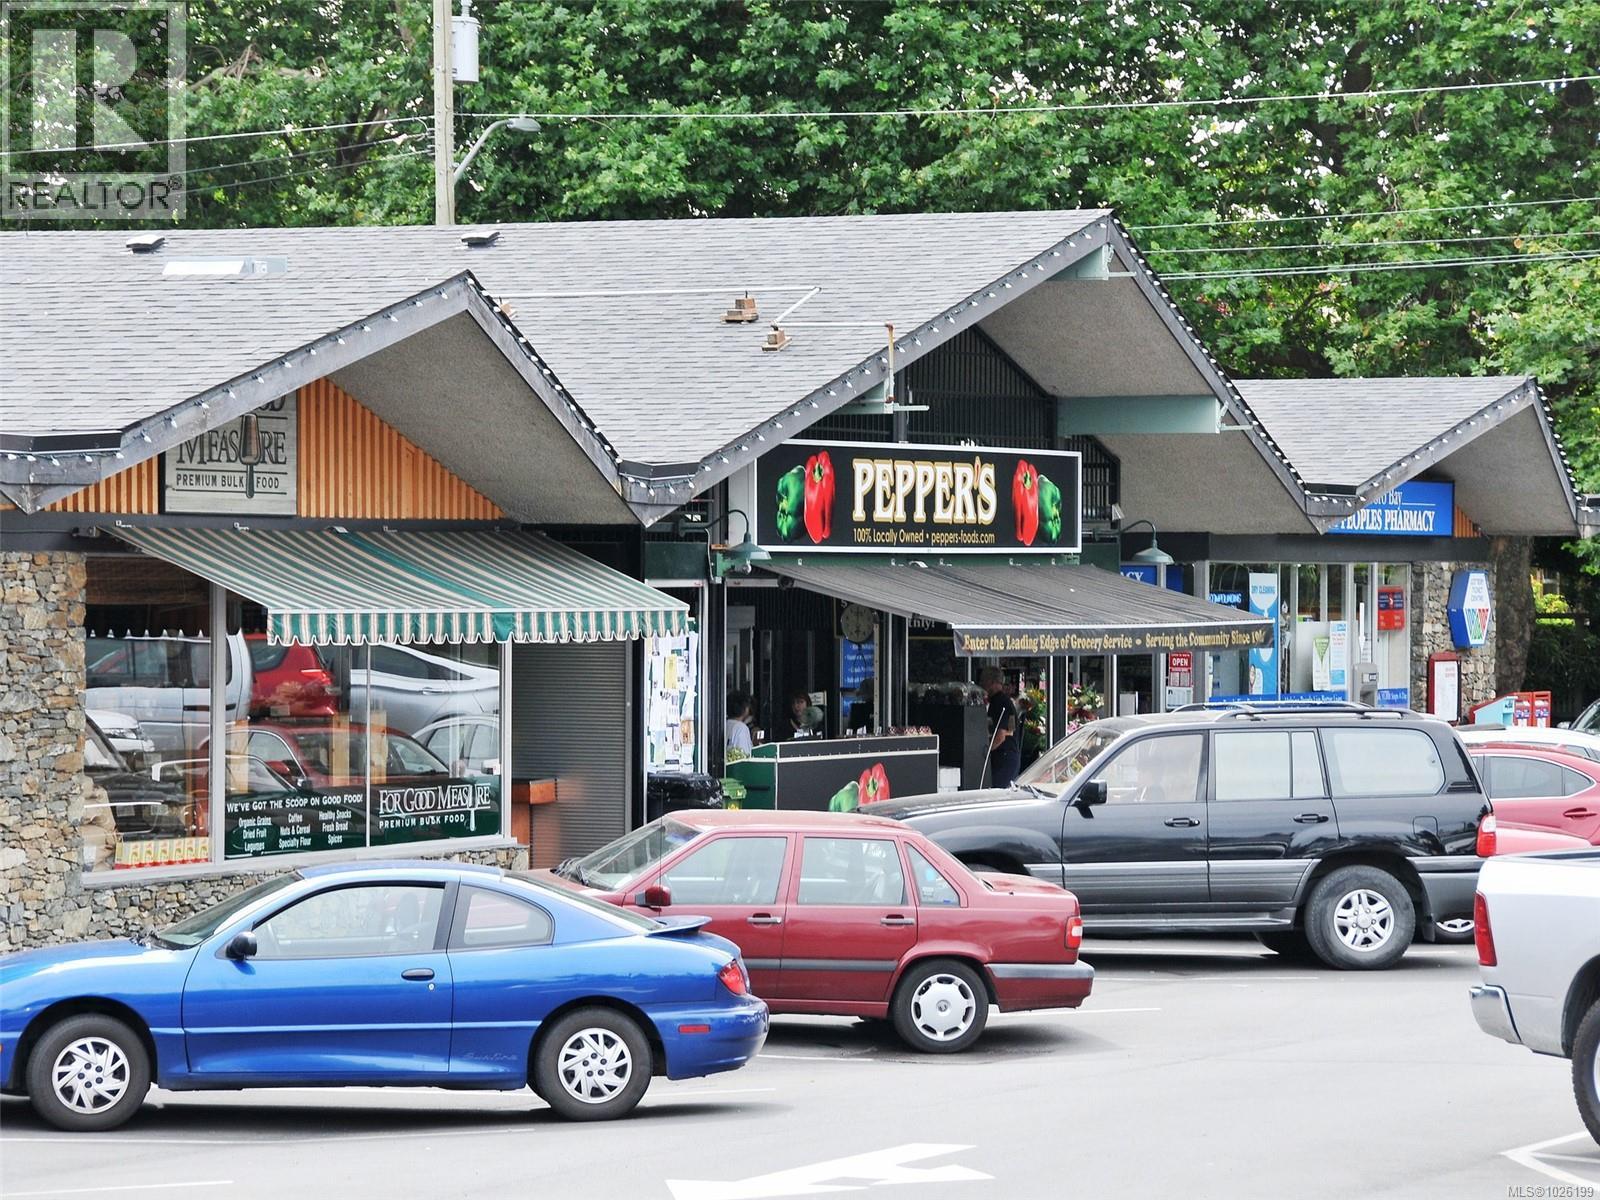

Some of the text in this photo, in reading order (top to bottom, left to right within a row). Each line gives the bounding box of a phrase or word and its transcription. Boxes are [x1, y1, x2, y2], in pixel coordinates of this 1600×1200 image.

[177, 474, 280, 489] PREMIUM BULK FOOD
[852, 456, 997, 525] PEPPER'S
[1388, 490, 1403, 510] Bay
[1384, 509, 1436, 532] PHARMACY
[853, 527, 995, 547] 100% Locally Owned peppers-foods.com
[962, 634, 989, 651] Enter
[990, 634, 1004, 651] the
[1006, 634, 1039, 653] Leading
[1040, 634, 1060, 653] Edge
[1061, 634, 1071, 650] of
[1071, 633, 1103, 652] Grocery
[1104, 633, 1132, 649] Service
[1146, 632, 1174, 650] Serving
[1176, 632, 1189, 647] the
[1189, 630, 1230, 648] Community
[1231, 630, 1251, 645] Since
[1172, 657, 1189, 667] OPEN
[227, 793, 363, 813] WE'VE GOT THE SCOOP ON GOOD FOOD!
[379, 784, 491, 816] FOR GOOD MEASURE
[239, 815, 272, 828] Organic Grains
[288, 812, 303, 823] Coffee
[318, 809, 352, 822] Healthy Snacks
[379, 818, 416, 830] PREMIUM
[444, 813, 465, 824] FOOD
[280, 826, 290, 836] Nuts
[296, 824, 311, 835] Cereal
[322, 821, 349, 833] Fresh Bread
[242, 828, 267, 840] Dried Fruit
[327, 833, 343, 845] Spices
[244, 841, 265, 852] Legumes
[279, 836, 312, 849] Specialty Flour
